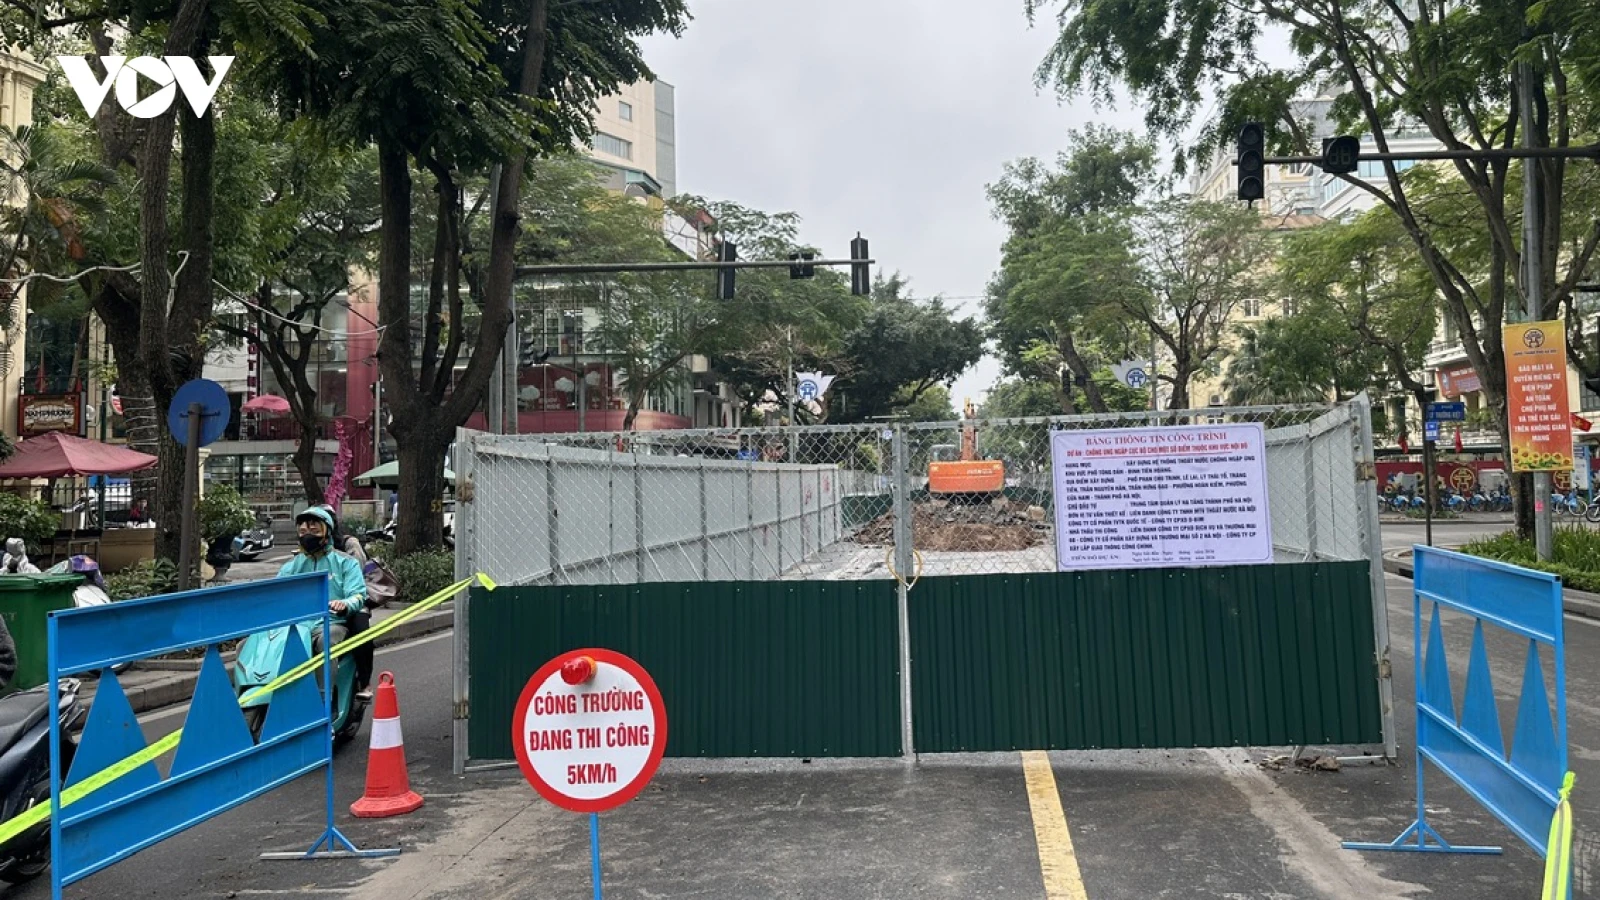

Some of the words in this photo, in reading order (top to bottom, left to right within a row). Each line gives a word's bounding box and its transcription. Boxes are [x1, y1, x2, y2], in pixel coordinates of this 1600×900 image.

[1085, 436, 1111, 445] BẢNG
[1114, 435, 1146, 444] THÔNG
[1149, 434, 1165, 443] TIN
[1166, 433, 1194, 442] CÔNG
[1197, 431, 1226, 441] TRÌNH
[534, 692, 577, 716] CÔNG
[581, 686, 643, 713] TRƯỜNG
[530, 729, 572, 751] ĐANG
[577, 727, 600, 749] THI
[606, 722, 650, 747] CÔNG
[567, 763, 617, 785] 5KM/h
